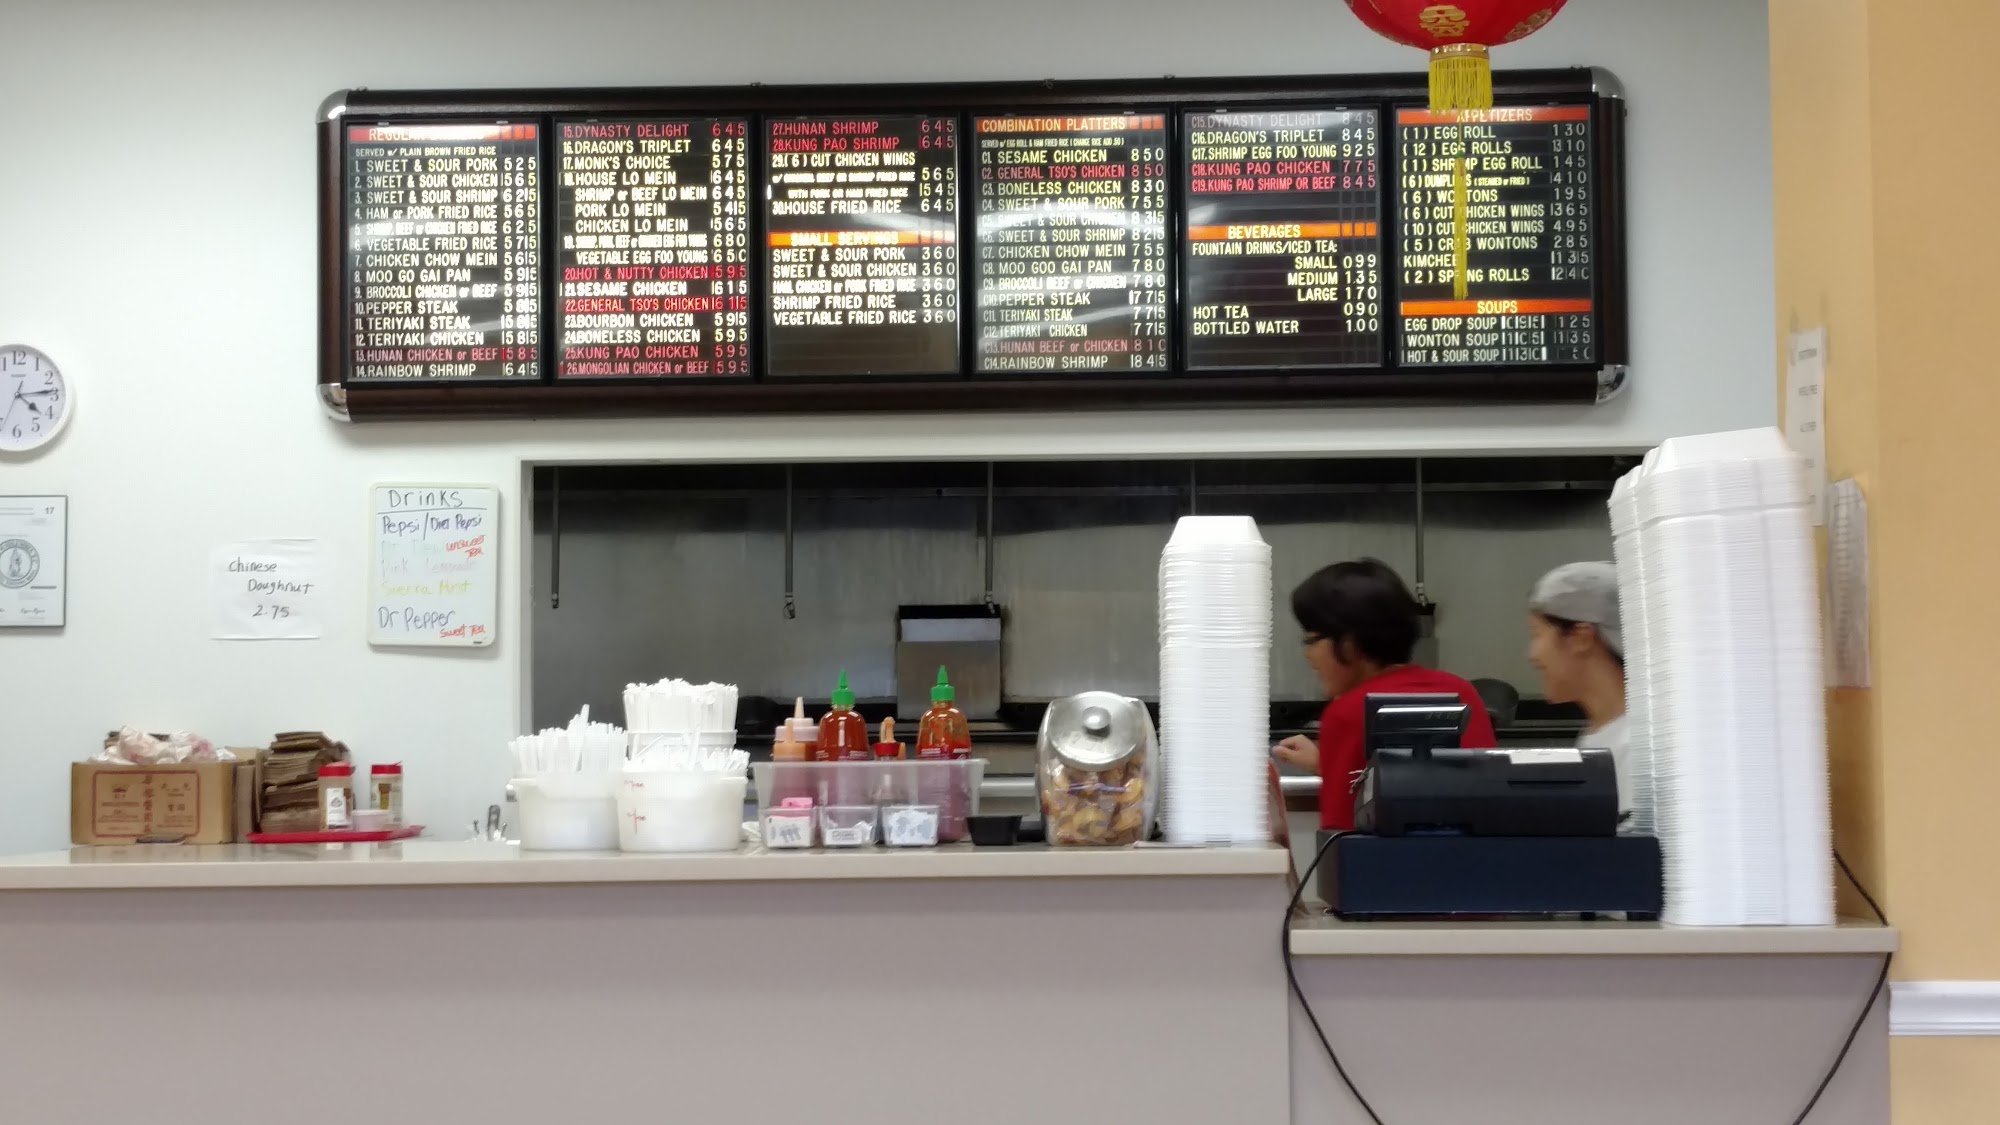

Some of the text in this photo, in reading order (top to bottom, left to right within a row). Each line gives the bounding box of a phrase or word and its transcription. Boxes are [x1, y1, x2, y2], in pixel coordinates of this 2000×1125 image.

[982, 118, 1125, 132] COMBINATION PLATTERS
[1271, 113, 1322, 126] DELIGHT
[638, 124, 689, 137] DELIGHT
[833, 122, 878, 134] SHRIMP
[1434, 126, 1496, 139] EGG ROLL
[1274, 129, 1324, 142] TRIPLET
[640, 140, 691, 152] TRIPLET
[824, 138, 899, 150] PAO SHRIMP
[1472, 142, 1511, 154] ROLLS
[998, 150, 1107, 163] SESAME CHICKEN
[1252, 145, 1336, 159] EGG FOO YOUNG
[367, 159, 497, 171] SWEET SOUR PORK
[626, 156, 670, 168] CHOICE
[811, 153, 915, 166] CUT CHICKEN WINGS
[1483, 157, 1542, 169] EGG ROLL
[1247, 161, 1330, 174] PAO CHICKEN
[367, 174, 497, 188] SWEET SOUR CHICKEN
[623, 172, 676, 184] LO MEIN
[1237, 177, 1335, 191] PAO SHRIMP OR BEEF
[998, 181, 1120, 195] BONELESS CHICKEN
[831, 200, 901, 213] FRIED RICE
[1511, 205, 1544, 216] WINGS
[576, 219, 688, 232] CHICKEN LO MEIN
[999, 228, 1125, 242] SWEET SOUR SHRIMP
[1228, 226, 1300, 239] BEVERAGES
[367, 237, 497, 250] VEGETABLE FRIED RICE
[1193, 242, 1242, 255] FOUNTAIN
[1477, 236, 1537, 249] WONTONS
[576, 251, 708, 264] VEGETABLE EGG FOO YOUNG
[773, 248, 905, 262] SWEET SOUR PORK
[1000, 244, 1125, 258] CHICKEN CHOW MEIN
[367, 253, 497, 267] CHICKEN CHOW MEIN
[1000, 260, 1111, 273] MOO GOO GAI PAN
[1295, 256, 1337, 269] SMALL
[367, 270, 470, 282] MOO GO GAI PAN
[618, 266, 708, 279] NUTTY CHICKEN
[1288, 273, 1338, 285] MEDIUM
[1489, 269, 1529, 281] ROLLS
[633, 282, 687, 295] CHICKEN
[1298, 289, 1338, 301] LARGE
[630, 298, 708, 310] TSO'S CHICKEN
[773, 295, 896, 309] SHRIMP FRIED RICE
[1050, 293, 1090, 305] STEAK
[418, 301, 458, 313] STEAK
[1194, 306, 1249, 319] HOT TEA
[1477, 301, 1517, 313] SOUPS
[640, 314, 693, 327] CHICKEN
[774, 311, 916, 325] VEGETABLE FRIED RICE
[1045, 309, 1072, 321] STEAK
[430, 317, 470, 329] STEAK
[1194, 321, 1298, 335] BOTTLED WATER
[1405, 317, 1497, 331] EGG DROP SOUP
[647, 329, 700, 342] CHICKEN
[1050, 324, 1087, 336] CHICKEN
[430, 333, 484, 345] CHICKEN
[1408, 333, 1498, 347] WONTON SOUP
[12, 351, 26, 365] 12
[616, 345, 698, 358] PAO CHICKEN
[1407, 350, 1499, 362] HOT SOUR SOUP
[1062, 356, 1108, 368] SHRIMP
[430, 364, 476, 376] SHRIMP
[45, 371, 53, 384] 2
[13, 424, 21, 438] 6
[32, 417, 40, 432] 5
[378, 606, 455, 631] Dr Pepper
